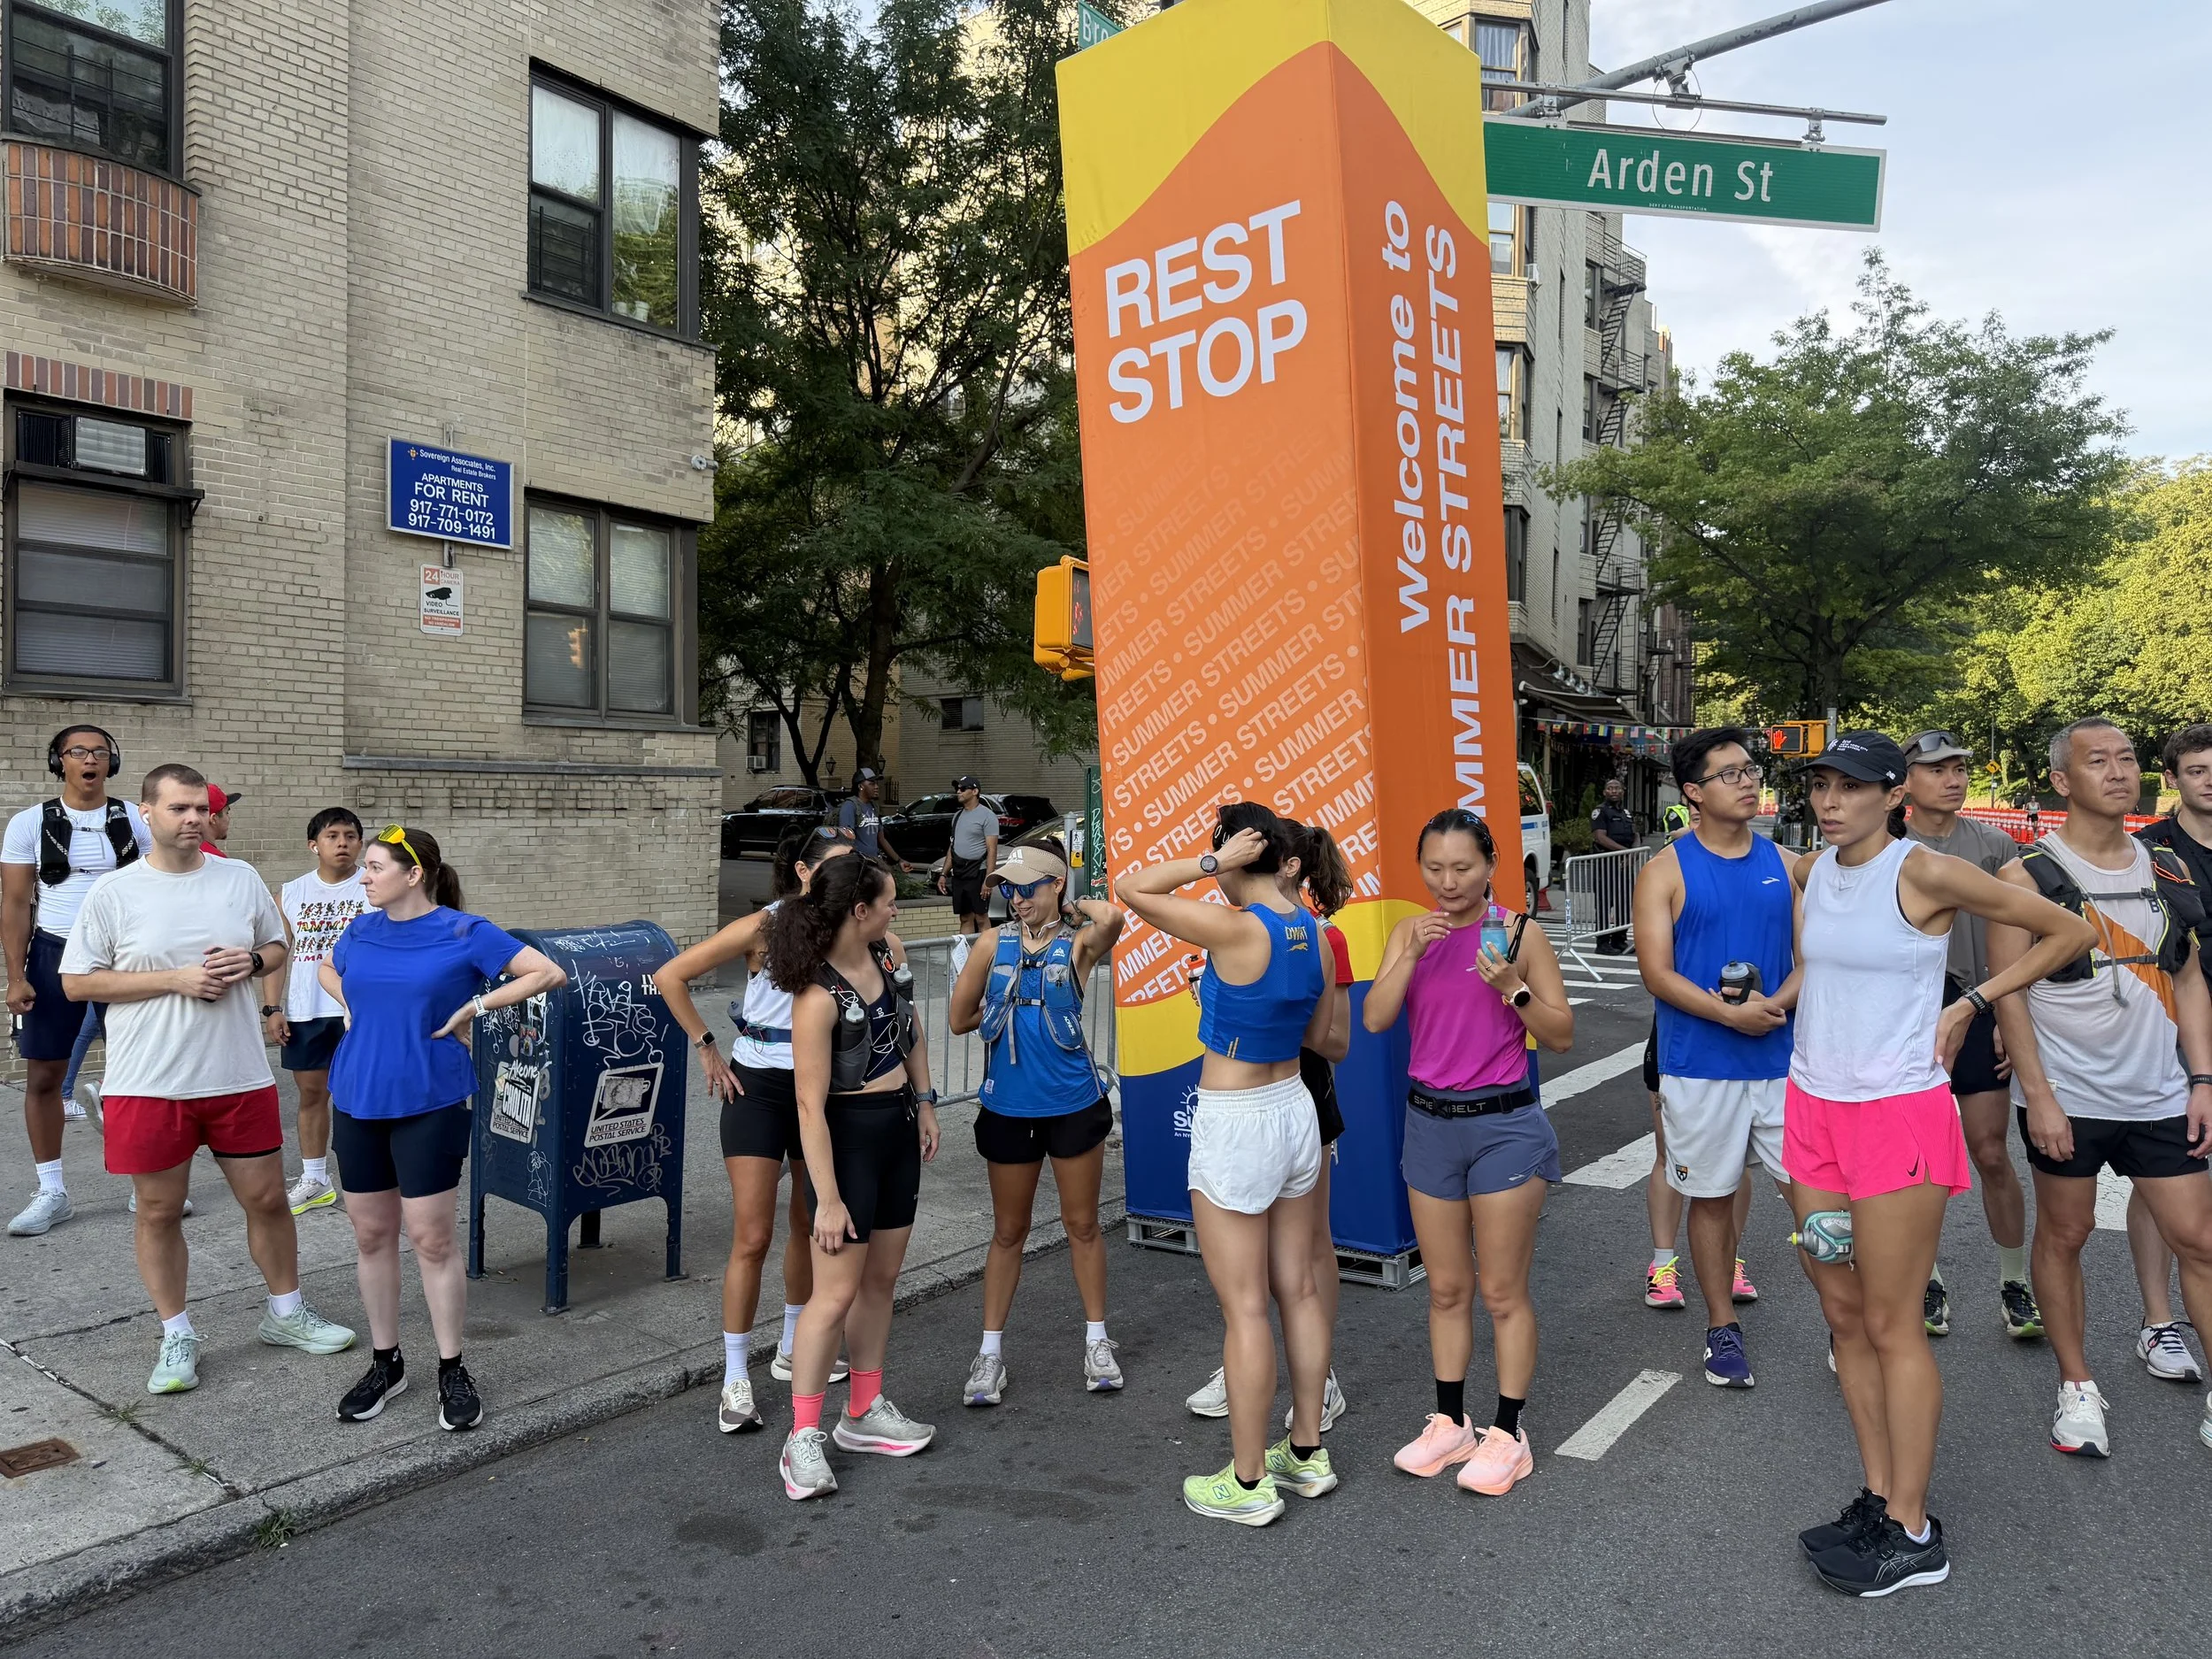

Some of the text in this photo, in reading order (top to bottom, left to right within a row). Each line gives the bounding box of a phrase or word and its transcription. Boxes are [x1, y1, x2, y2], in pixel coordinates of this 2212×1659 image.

[1586, 149, 1774, 203] Arden St
[1105, 200, 1302, 339] REST
[1108, 299, 1308, 425] STOP
[1381, 201, 1430, 634] Welcome to
[419, 449, 496, 472] Sovereign Associates, Inc.
[421, 472, 484, 493] APARTMENTS
[450, 465, 496, 480] Real Estate Brokers
[410, 498, 494, 526] 917-771-0172
[414, 481, 489, 508] FOR RENT
[408, 513, 496, 540] 917-709-1491
[1149, 497, 1246, 596] SUMMER
[1425, 225, 1486, 818] MMER STREETS
[425, 571, 460, 581] 24 HOUR
[1166, 526, 1267, 626] STREETS
[424, 608, 460, 617] SURVEILLANCE
[1183, 559, 1285, 657] SUMMER
[1111, 679, 1203, 766] SUMMER
[1201, 588, 1306, 687] STREETS
[1113, 622, 1325, 808] STREETS SUMMER
[1255, 688, 1365, 782] SUMMER
[1143, 653, 1346, 828] SUMMER STREETS
[493, 1121, 510, 1133] POSTAL
[510, 1125, 529, 1139] SERVICE
[494, 1112, 511, 1125] UNITED
[502, 1081, 533, 1131] CHOLITA
[591, 1117, 645, 1134] UNITED STATES
[589, 1125, 647, 1142] POSTAL SERVICE
